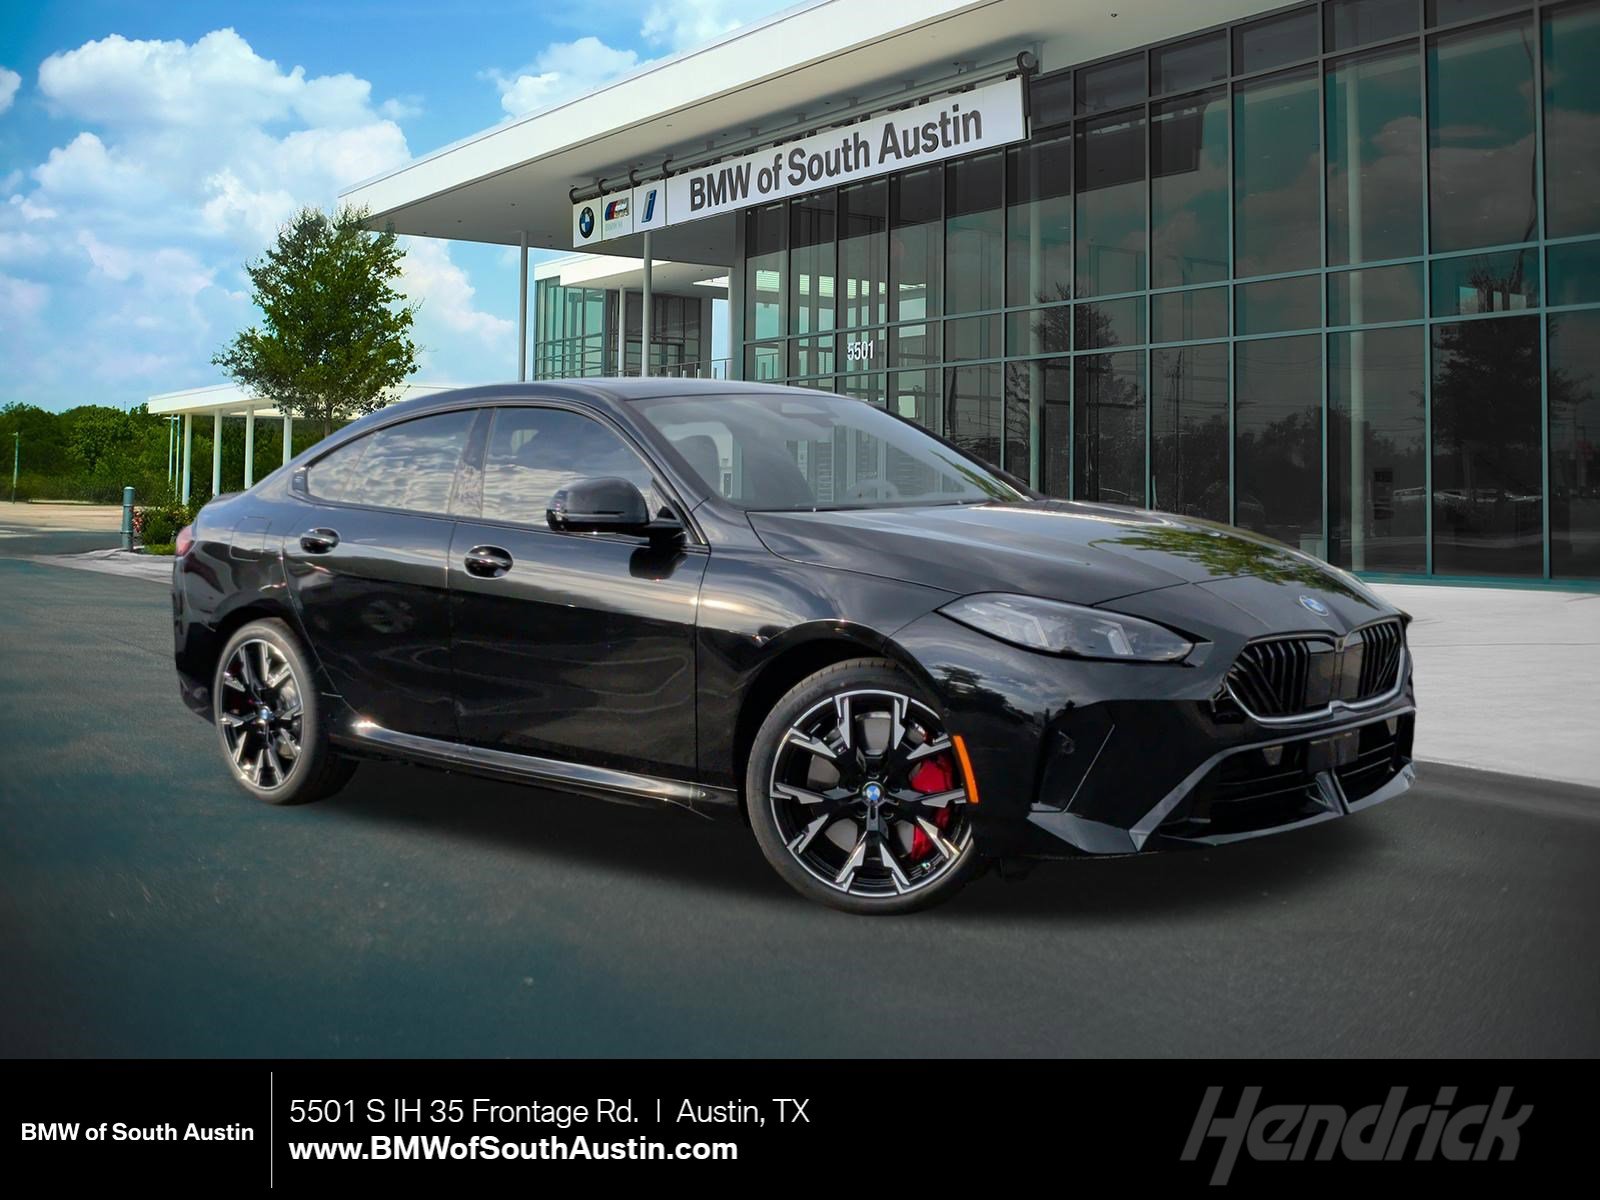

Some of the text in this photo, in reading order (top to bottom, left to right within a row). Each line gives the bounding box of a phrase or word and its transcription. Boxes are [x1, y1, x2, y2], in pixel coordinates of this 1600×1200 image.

[690, 162, 752, 212] BMW
[757, 153, 783, 194] of
[787, 131, 871, 186] South
[878, 103, 982, 165] Austin
[847, 340, 874, 361] 5501
